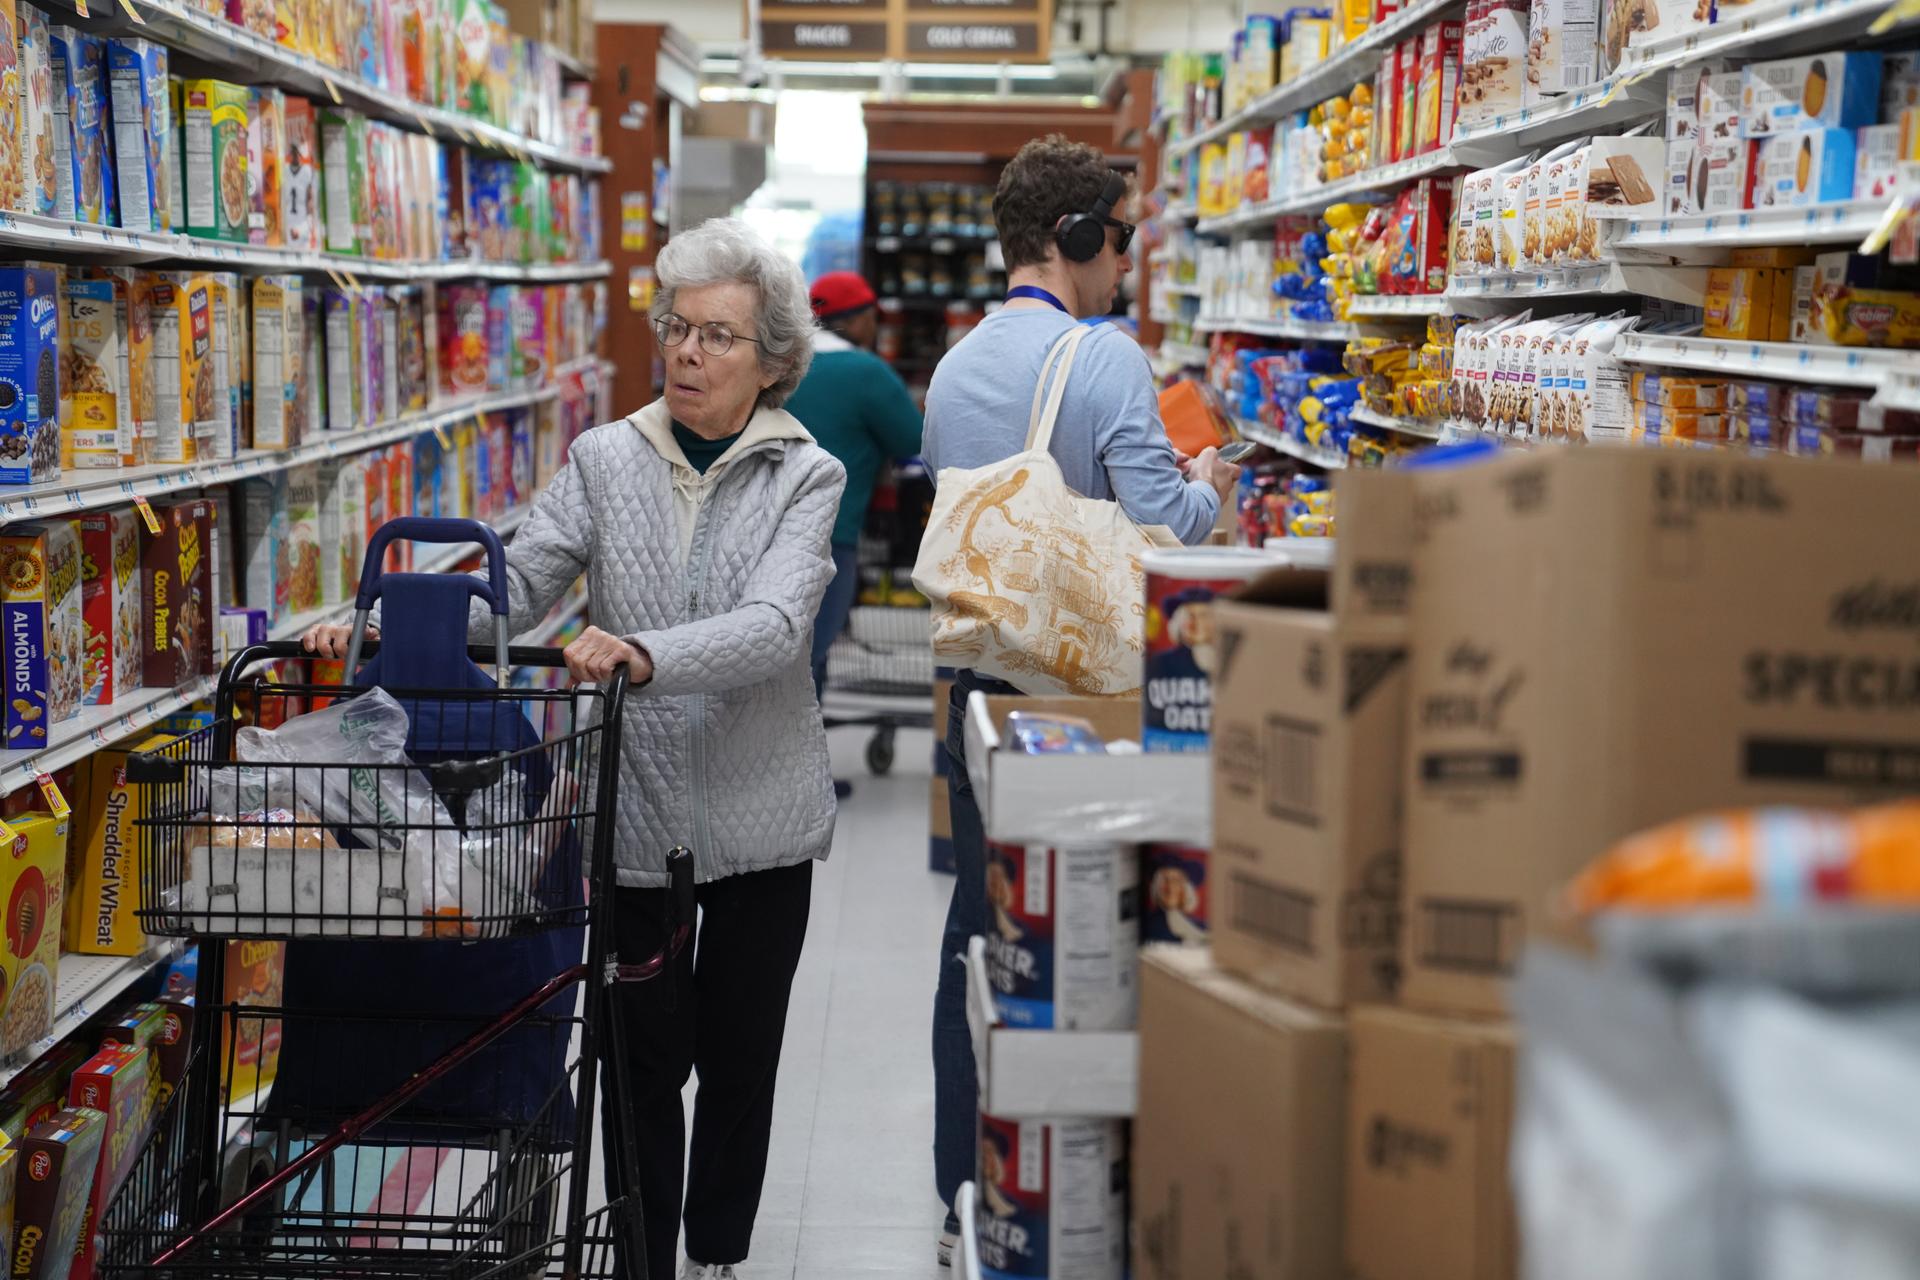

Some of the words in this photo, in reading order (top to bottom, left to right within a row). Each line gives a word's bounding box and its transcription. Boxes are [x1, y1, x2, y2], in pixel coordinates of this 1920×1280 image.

[795, 25, 848, 45] SNACKS
[926, 26, 963, 46] COLD
[965, 27, 1015, 47] CEREAL
[31, 294, 55, 323] OREO
[73, 438, 94, 447] TERS
[16, 579, 38, 589] OATS
[154, 570, 170, 607] COCOA
[13, 611, 31, 692] ALMONDS
[1164, 705, 1211, 731] OAT
[102, 791, 128, 881] Shredded
[96, 882, 120, 947] Wheat
[35, 1155, 48, 1177] Post
[12, 1224, 43, 1275] COCOA
